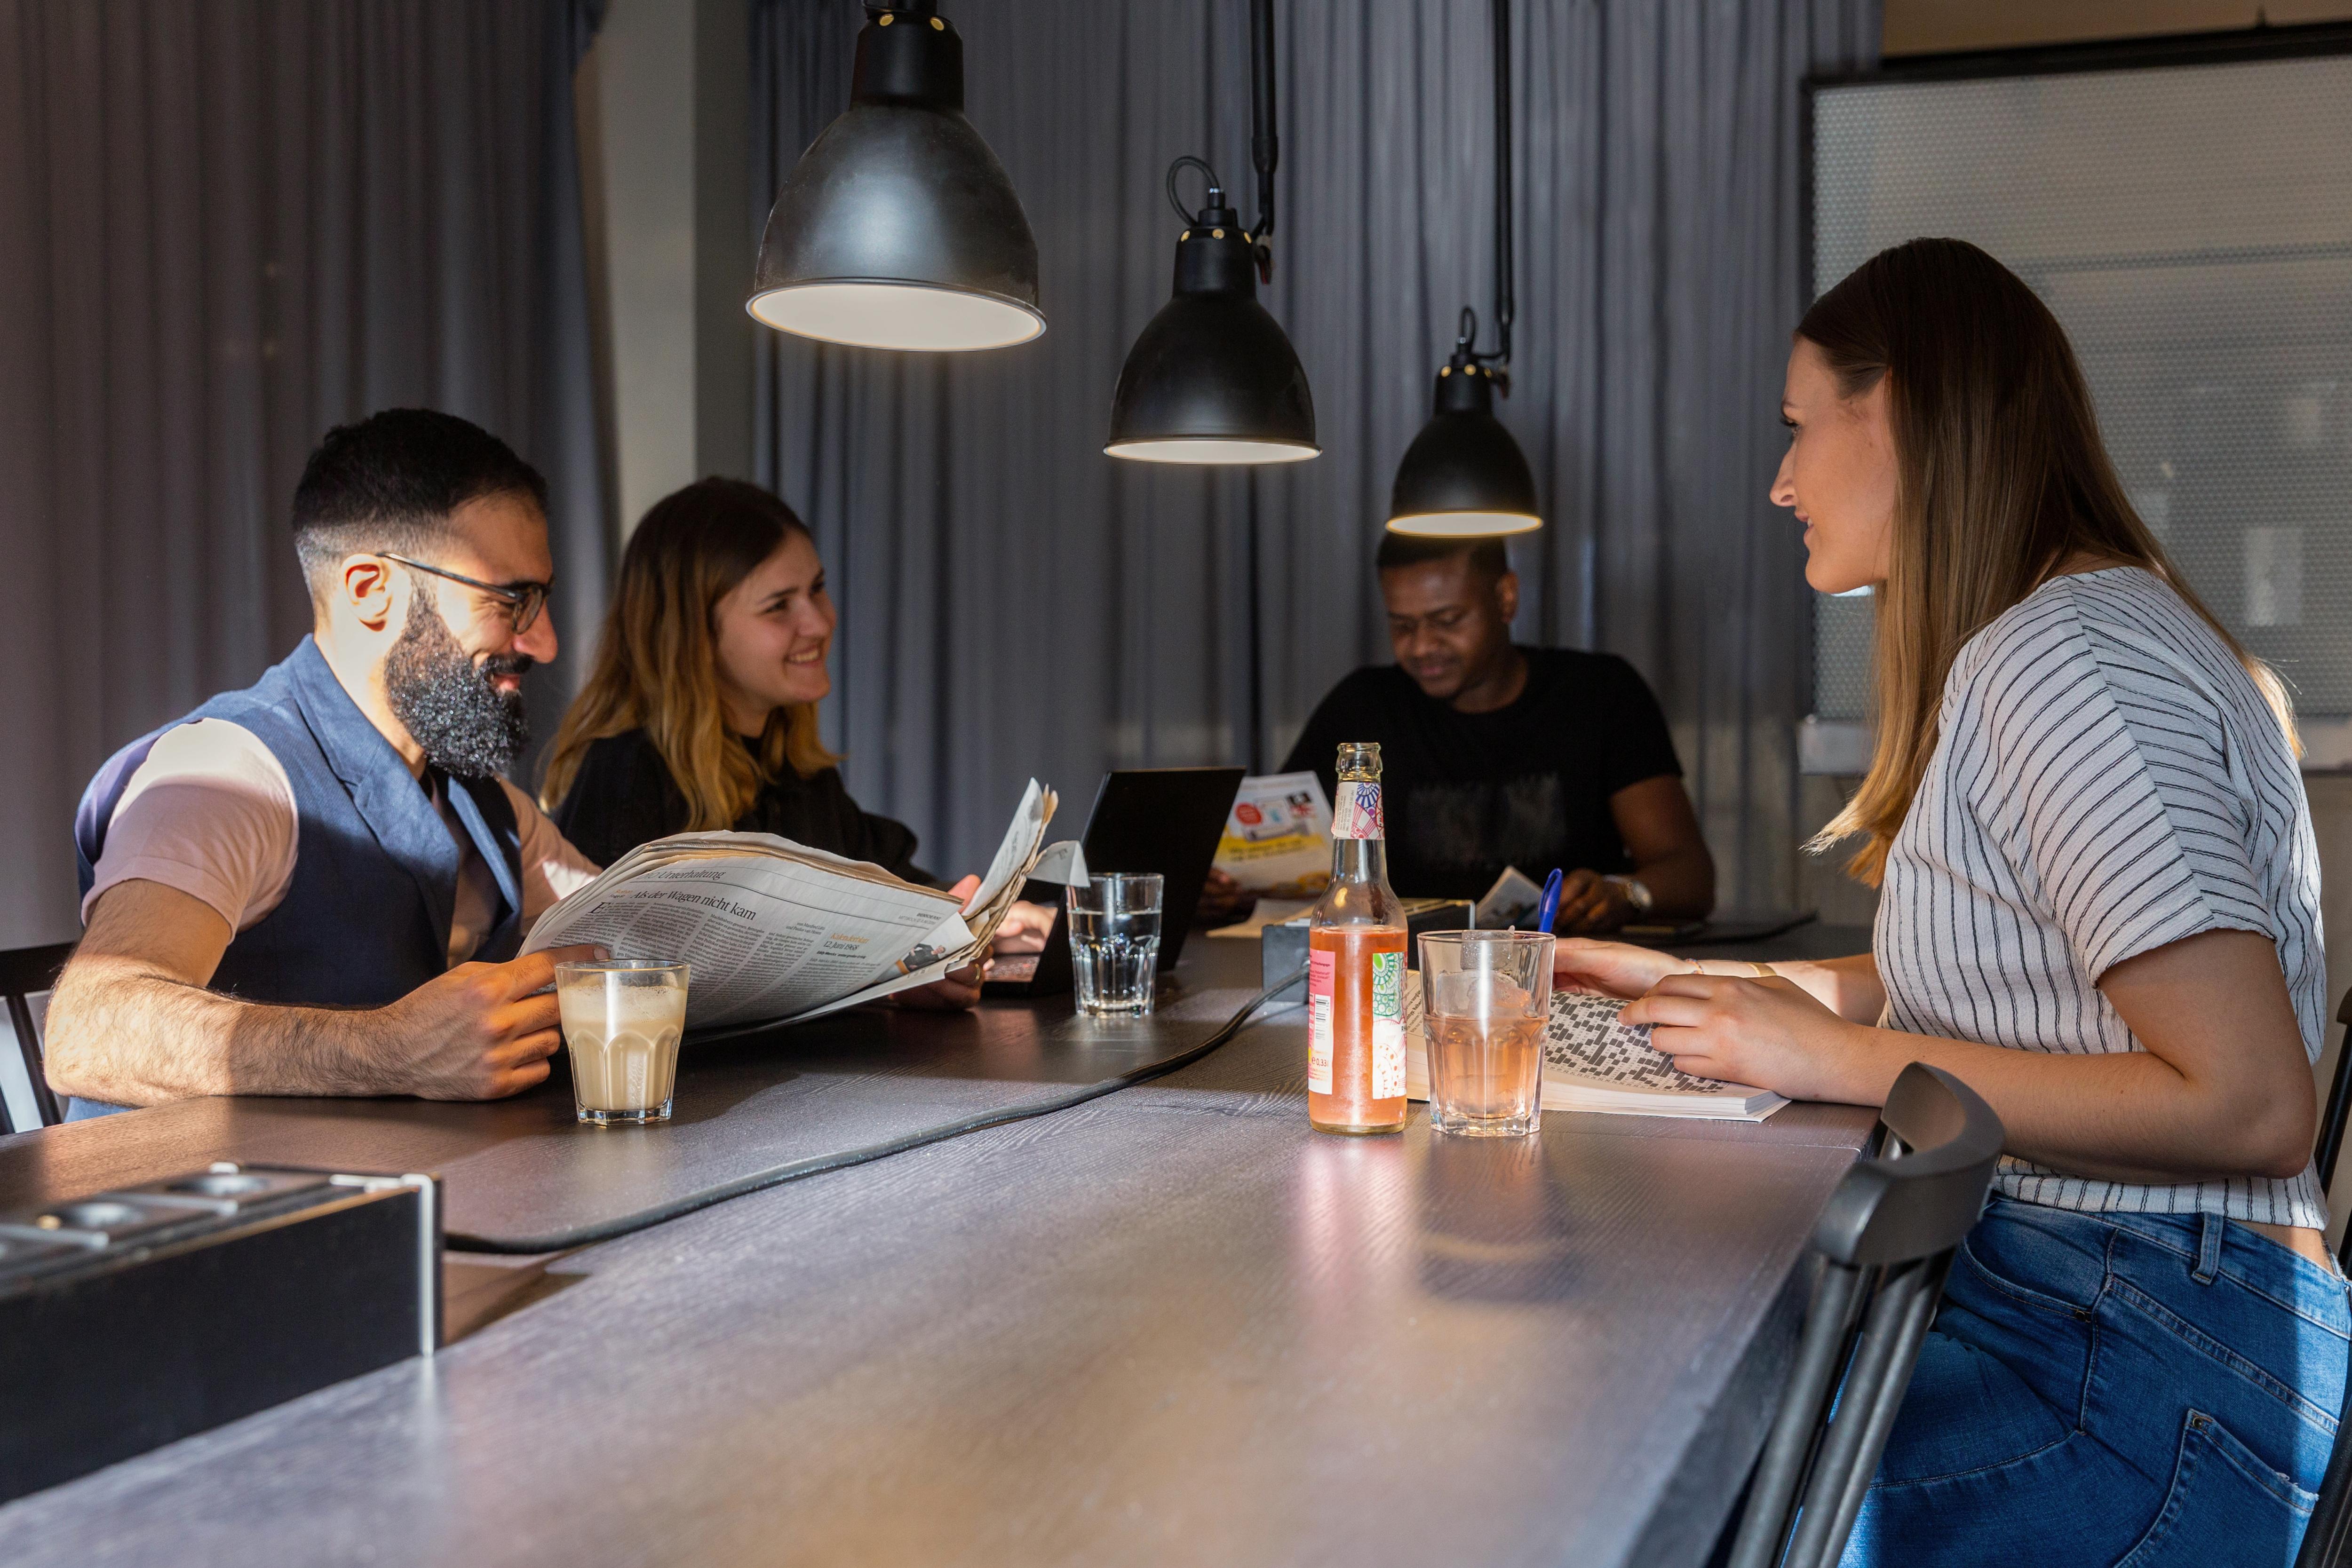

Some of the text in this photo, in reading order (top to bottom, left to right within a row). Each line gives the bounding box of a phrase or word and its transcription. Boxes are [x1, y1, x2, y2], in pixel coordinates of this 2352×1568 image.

[659, 870, 726, 880] Unterhaltung
[667, 891, 701, 903] Wagen
[700, 895, 732, 911] nicht
[730, 902, 757, 920] kam
